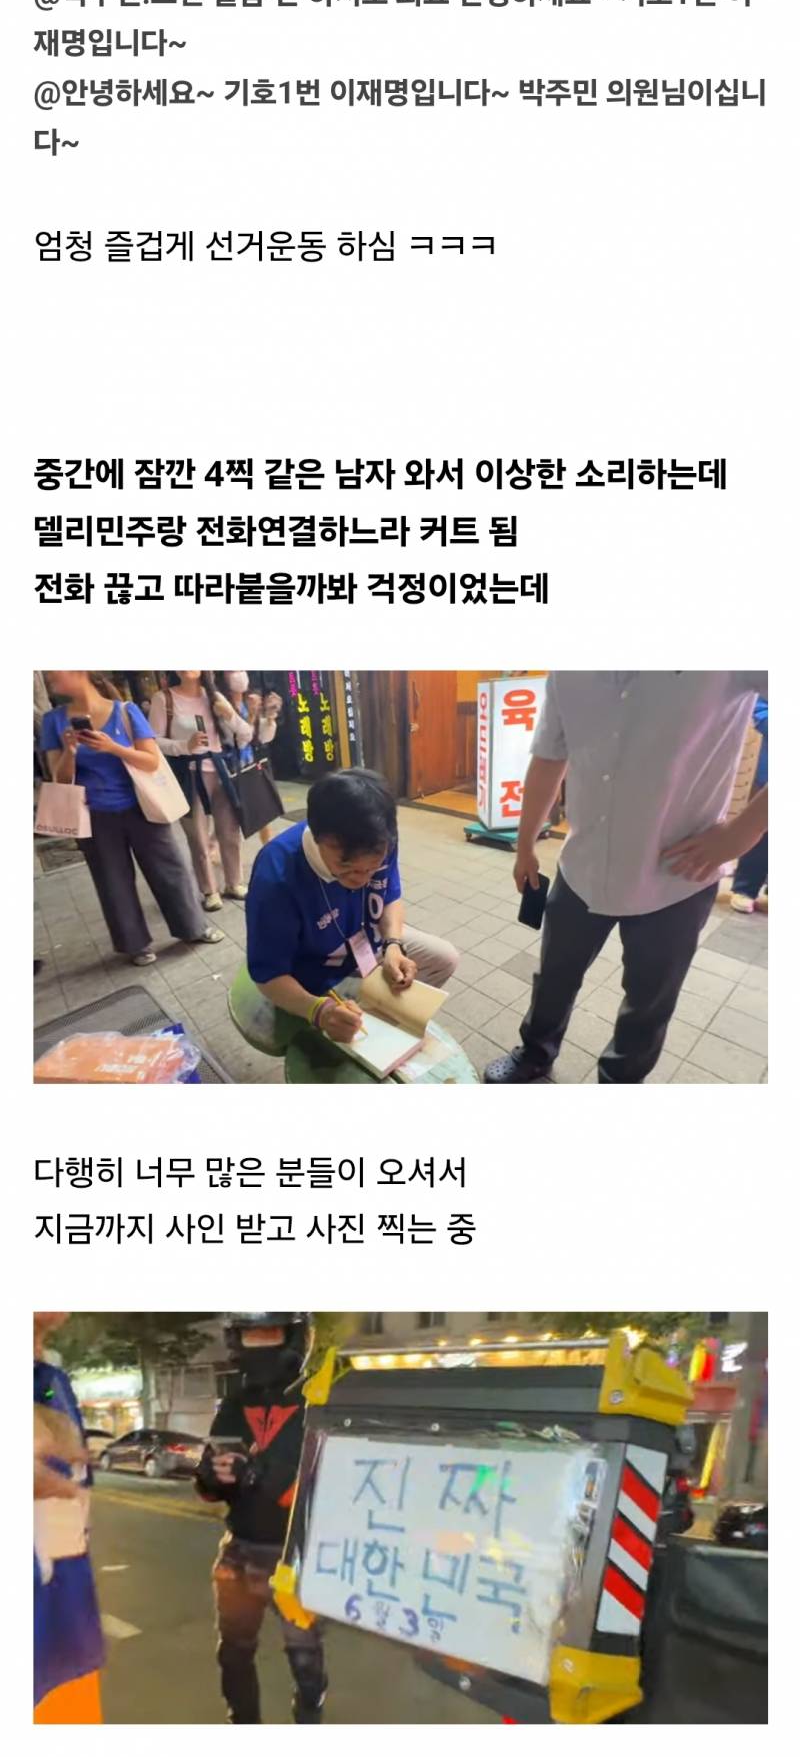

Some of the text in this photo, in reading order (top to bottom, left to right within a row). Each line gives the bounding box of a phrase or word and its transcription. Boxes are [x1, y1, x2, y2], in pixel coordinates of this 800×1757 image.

[297, 692, 314, 762] 노래방
[319, 692, 335, 761] 노래방
[353, 1456, 517, 1539] 진짜
